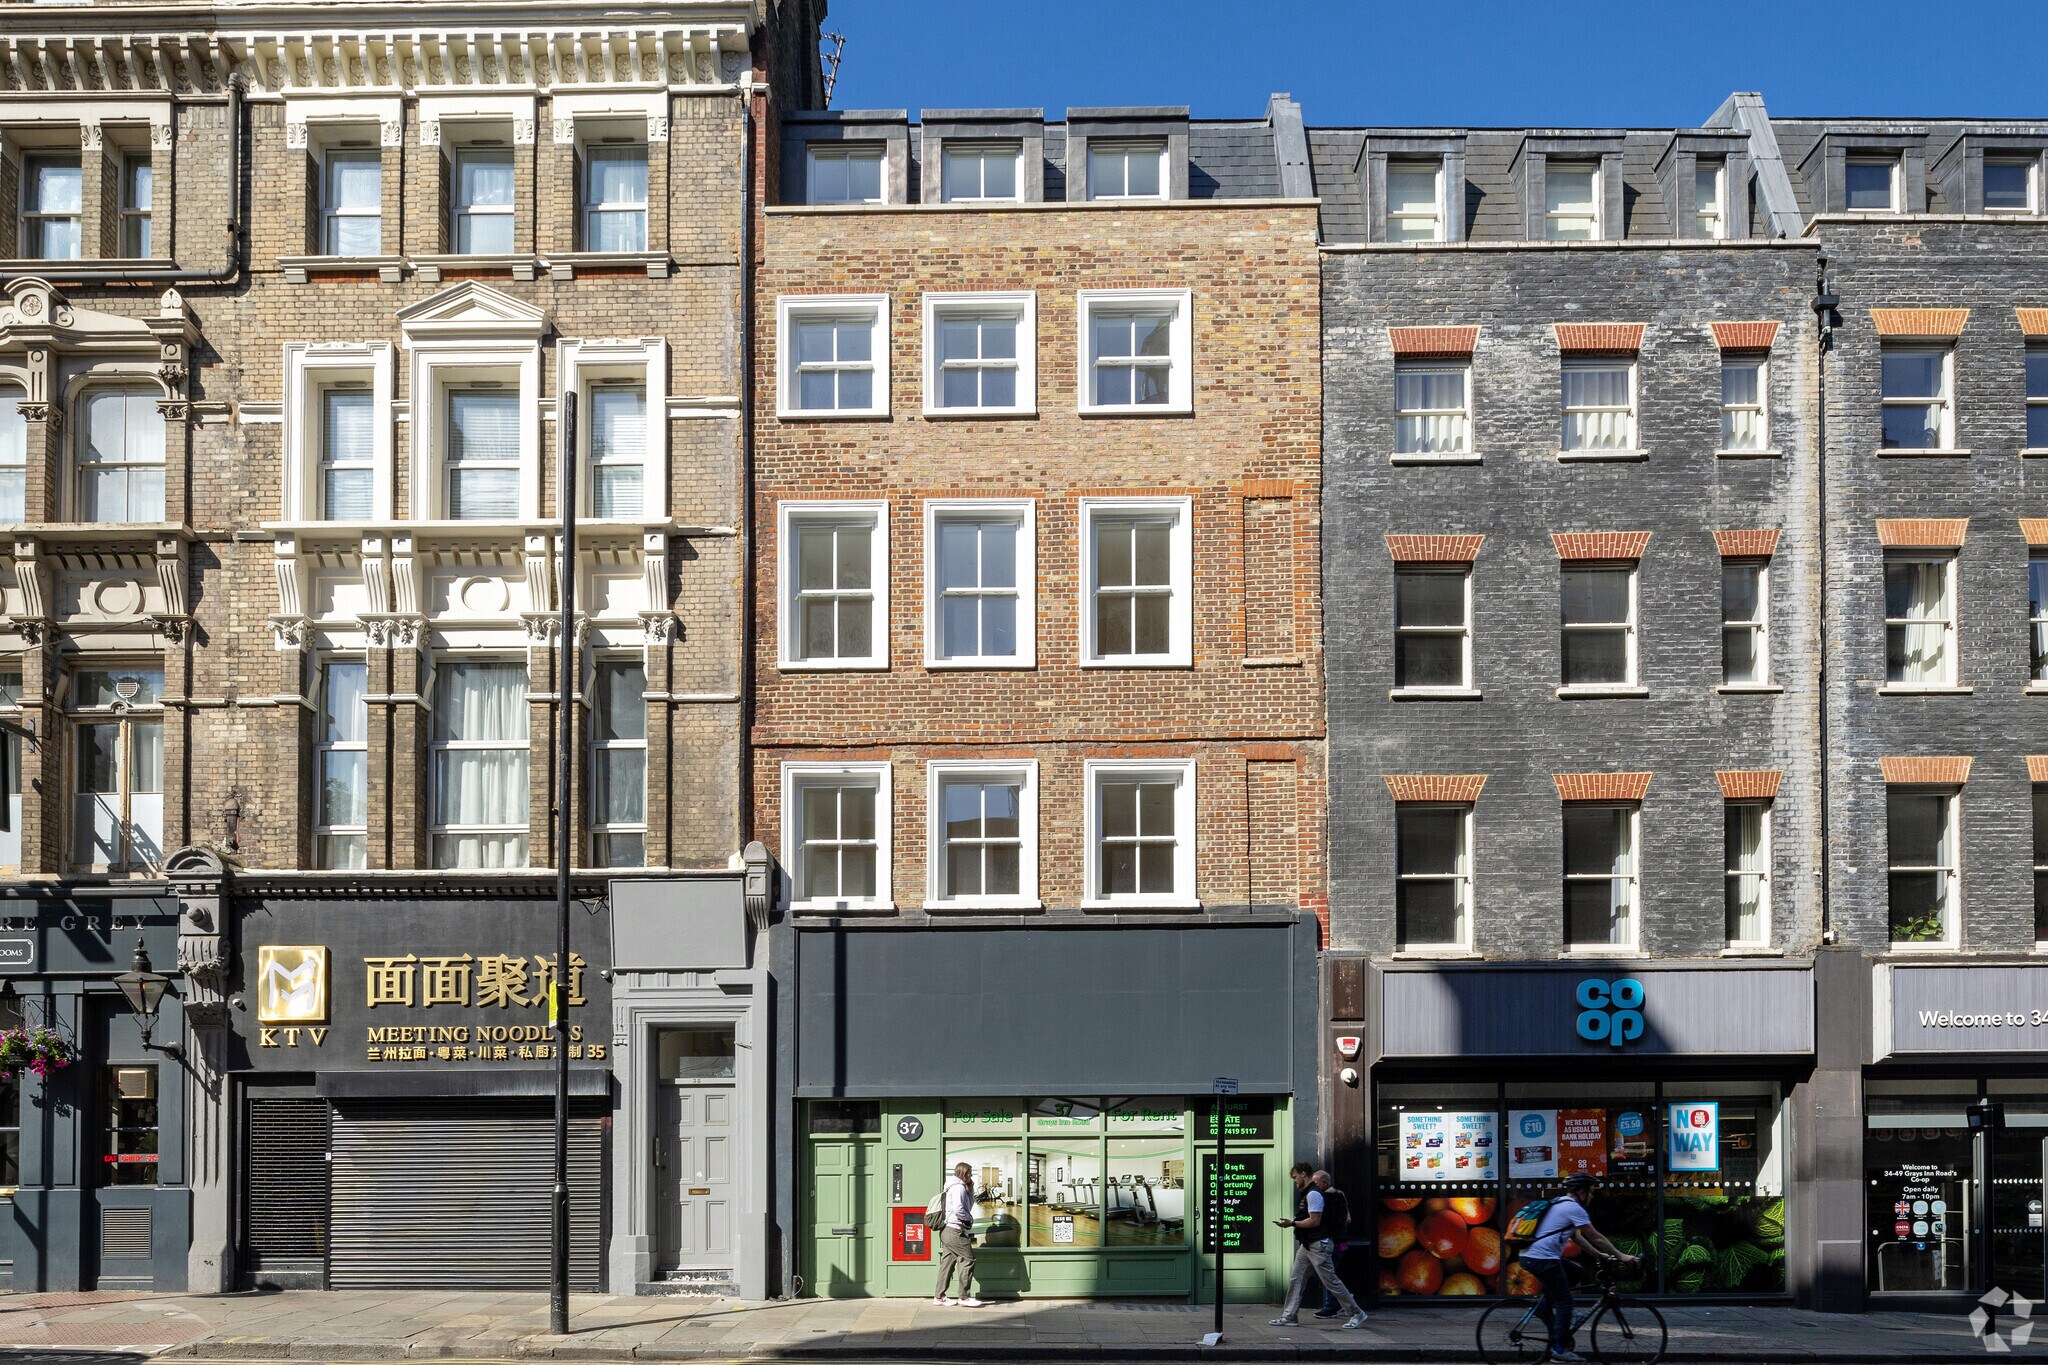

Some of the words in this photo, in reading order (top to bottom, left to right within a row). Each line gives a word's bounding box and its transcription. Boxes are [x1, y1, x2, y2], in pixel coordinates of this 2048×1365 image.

[60, 915, 147, 931] GREY
[363, 953, 587, 1008] 面面聚道
[1918, 1010, 2003, 1027] Welcome
[2005, 1012, 2025, 1027] to
[259, 1028, 328, 1047] KTV
[367, 1026, 469, 1042] MEETING
[476, 1025, 584, 1042] NOODLS
[587, 1044, 606, 1060] 35
[952, 1110, 977, 1123] For
[981, 1109, 1013, 1123] Sale
[1055, 1103, 1074, 1116] 37
[1111, 1109, 1136, 1122] For
[1140, 1107, 1178, 1121] Rent
[899, 1122, 919, 1134] 37
[1524, 1121, 1542, 1134] £10
[1620, 1119, 1641, 1130] £5.50
[1673, 1133, 1713, 1152] WAY
